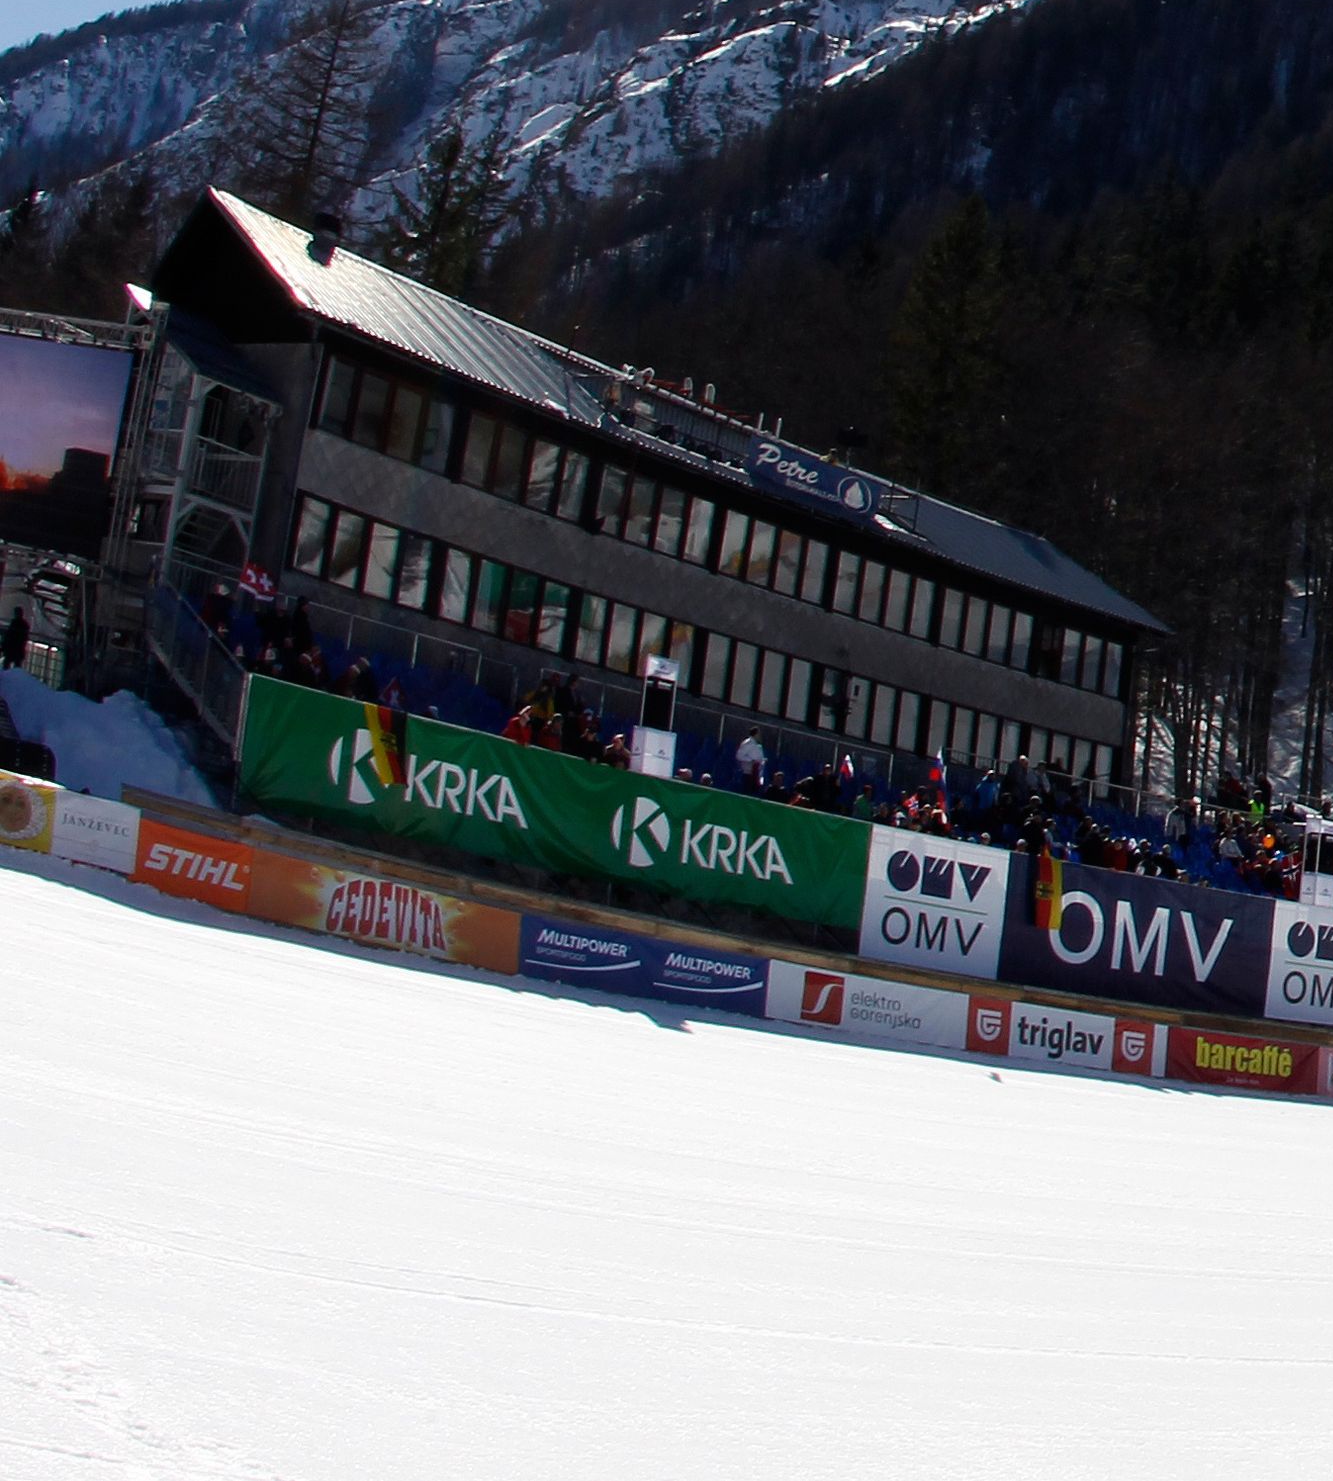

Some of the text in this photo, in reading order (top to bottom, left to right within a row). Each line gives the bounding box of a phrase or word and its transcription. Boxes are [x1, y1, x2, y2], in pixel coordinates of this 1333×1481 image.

[756, 442, 818, 484] Petre
[404, 754, 528, 830] KRKA
[144, 843, 244, 891] STIHL
[680, 819, 793, 885] KRKA
[325, 880, 446, 951] CEDEVITA
[881, 906, 984, 956] OMV
[1049, 891, 1234, 982] OMV
[850, 990, 901, 1012] elektro
[1018, 1016, 1103, 1059] triglav
